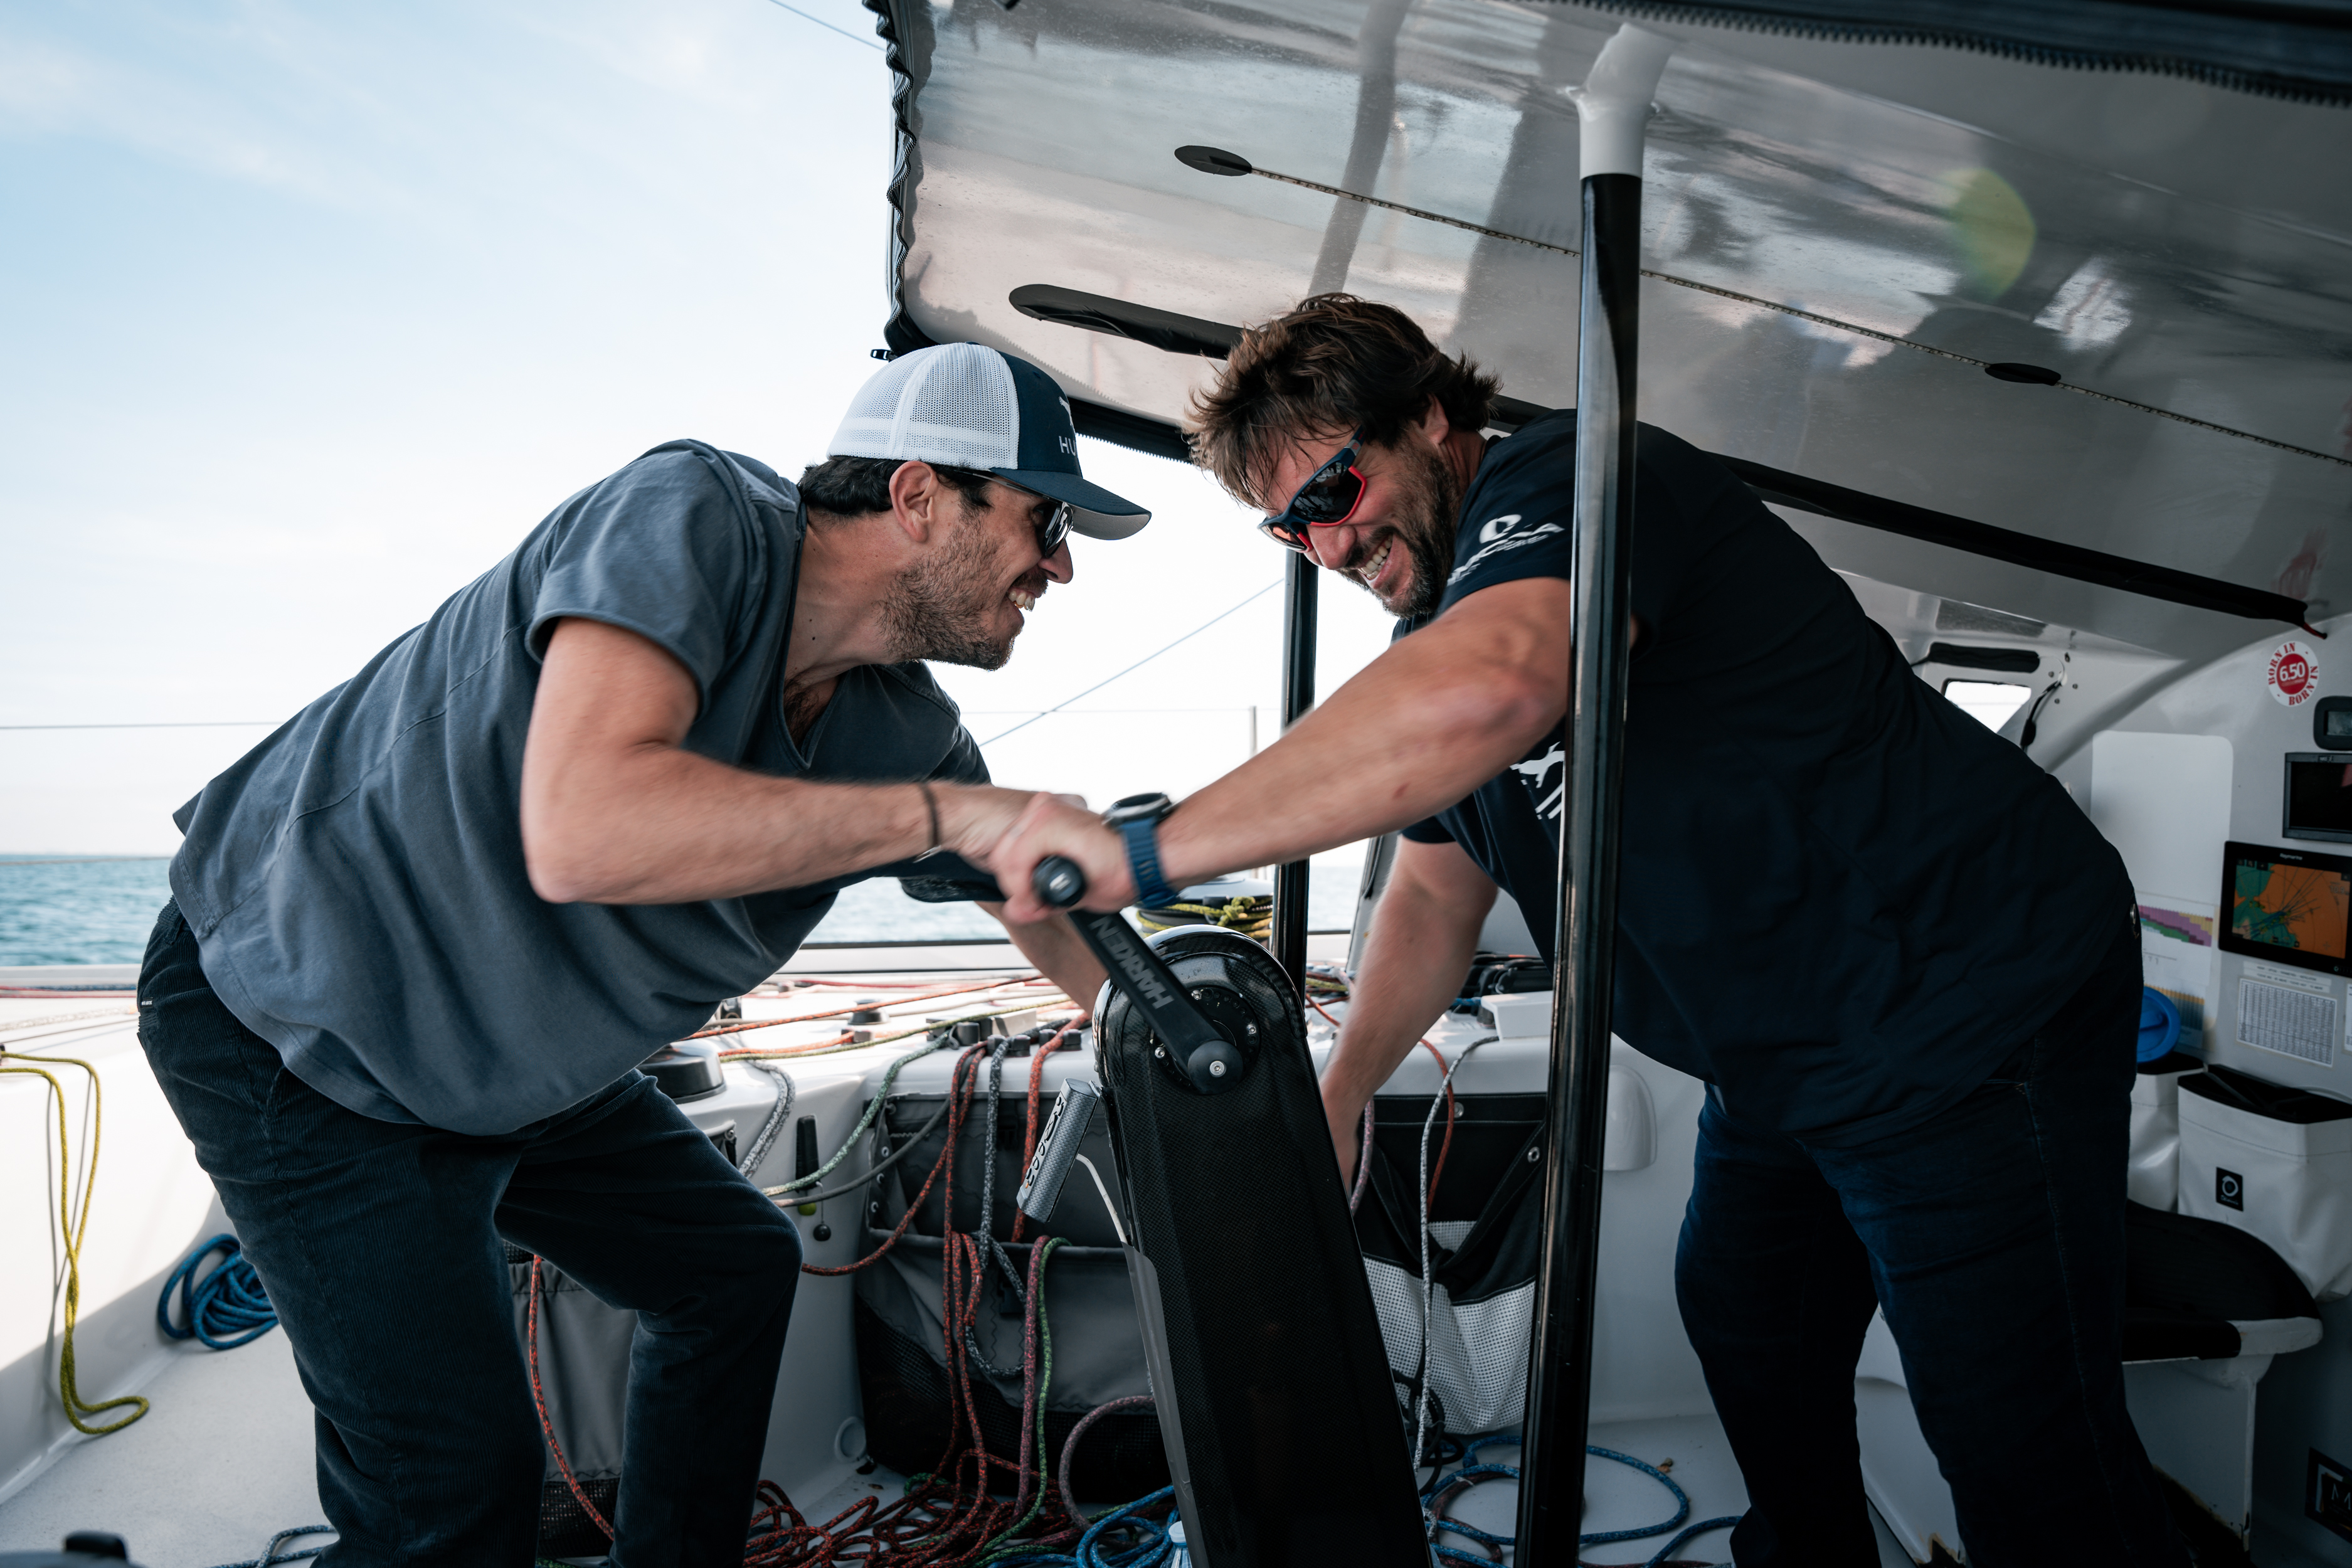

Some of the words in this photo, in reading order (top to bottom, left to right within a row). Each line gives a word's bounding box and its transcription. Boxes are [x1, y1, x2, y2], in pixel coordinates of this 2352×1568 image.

[2268, 650, 2282, 685] BORN
[2283, 642, 2296, 654] IN
[2279, 662, 2306, 682] 6.50
[2289, 682, 2315, 706] BORN
[2309, 665, 2319, 679] IN
[1088, 914, 1175, 1009] HARKEN
